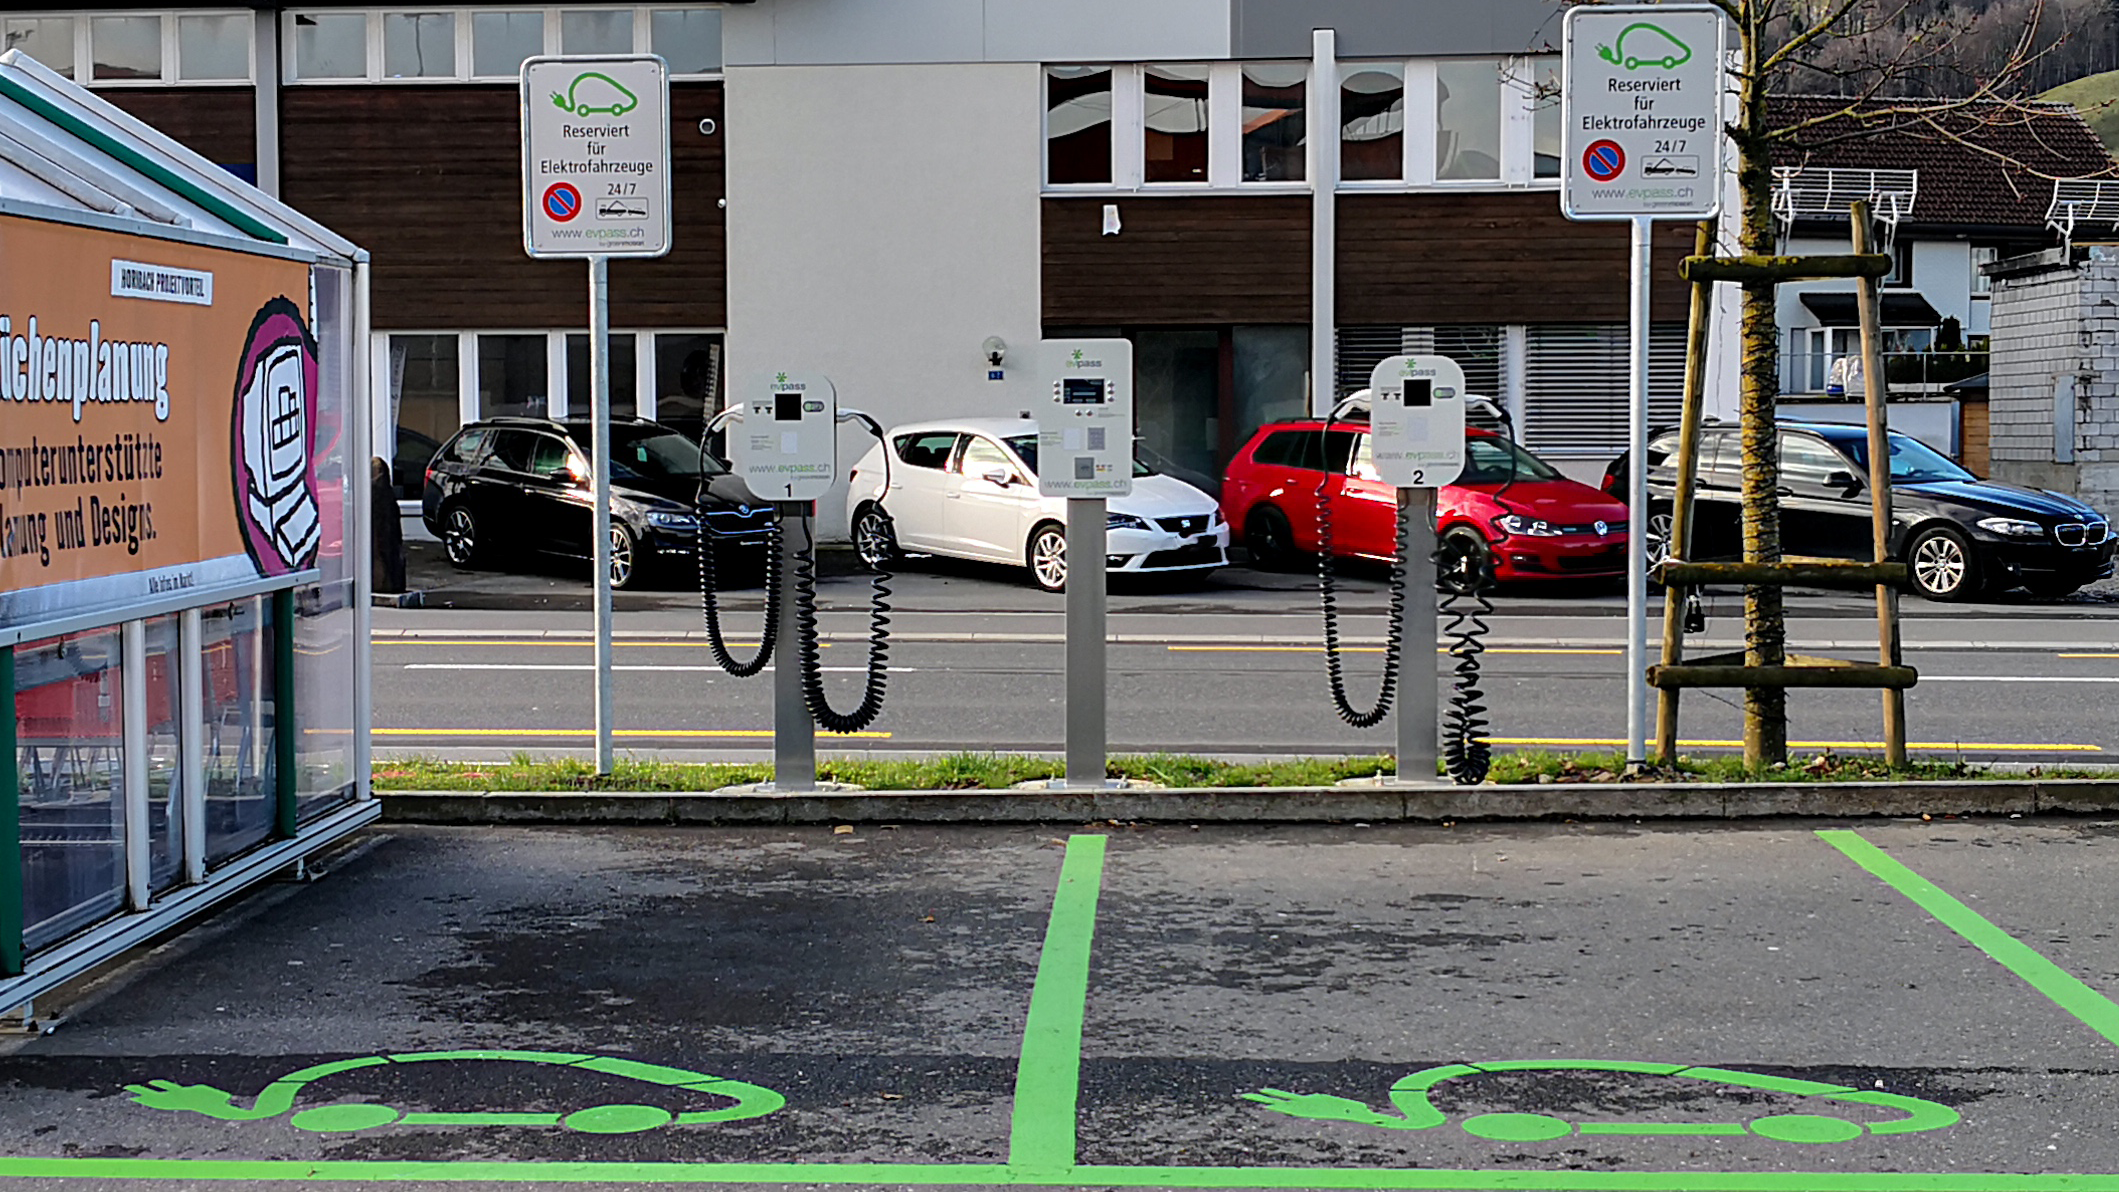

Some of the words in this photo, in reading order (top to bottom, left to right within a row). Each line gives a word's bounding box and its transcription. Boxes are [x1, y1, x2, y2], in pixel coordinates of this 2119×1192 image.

[1608, 78, 1681, 92] Reserviert
[1634, 95, 1655, 111] für
[1582, 115, 1706, 132] Elektrofahrzeuge
[563, 124, 630, 138] Reserviert
[587, 141, 606, 155] für
[1654, 140, 1686, 153] 24/7
[540, 159, 653, 176] Elektrofahrzeuge
[607, 183, 637, 195] 24/7
[1591, 186, 1693, 200] www.evpass.ch
[551, 227, 644, 240] www.evpass.ch
[749, 462, 831, 475] www.evpass.ch
[1413, 470, 1424, 485] 2
[784, 483, 792, 498] 1
[1044, 479, 1127, 491] www.evpass.ch
[54, 495, 86, 550] und
[90, 492, 157, 556] Designs.
